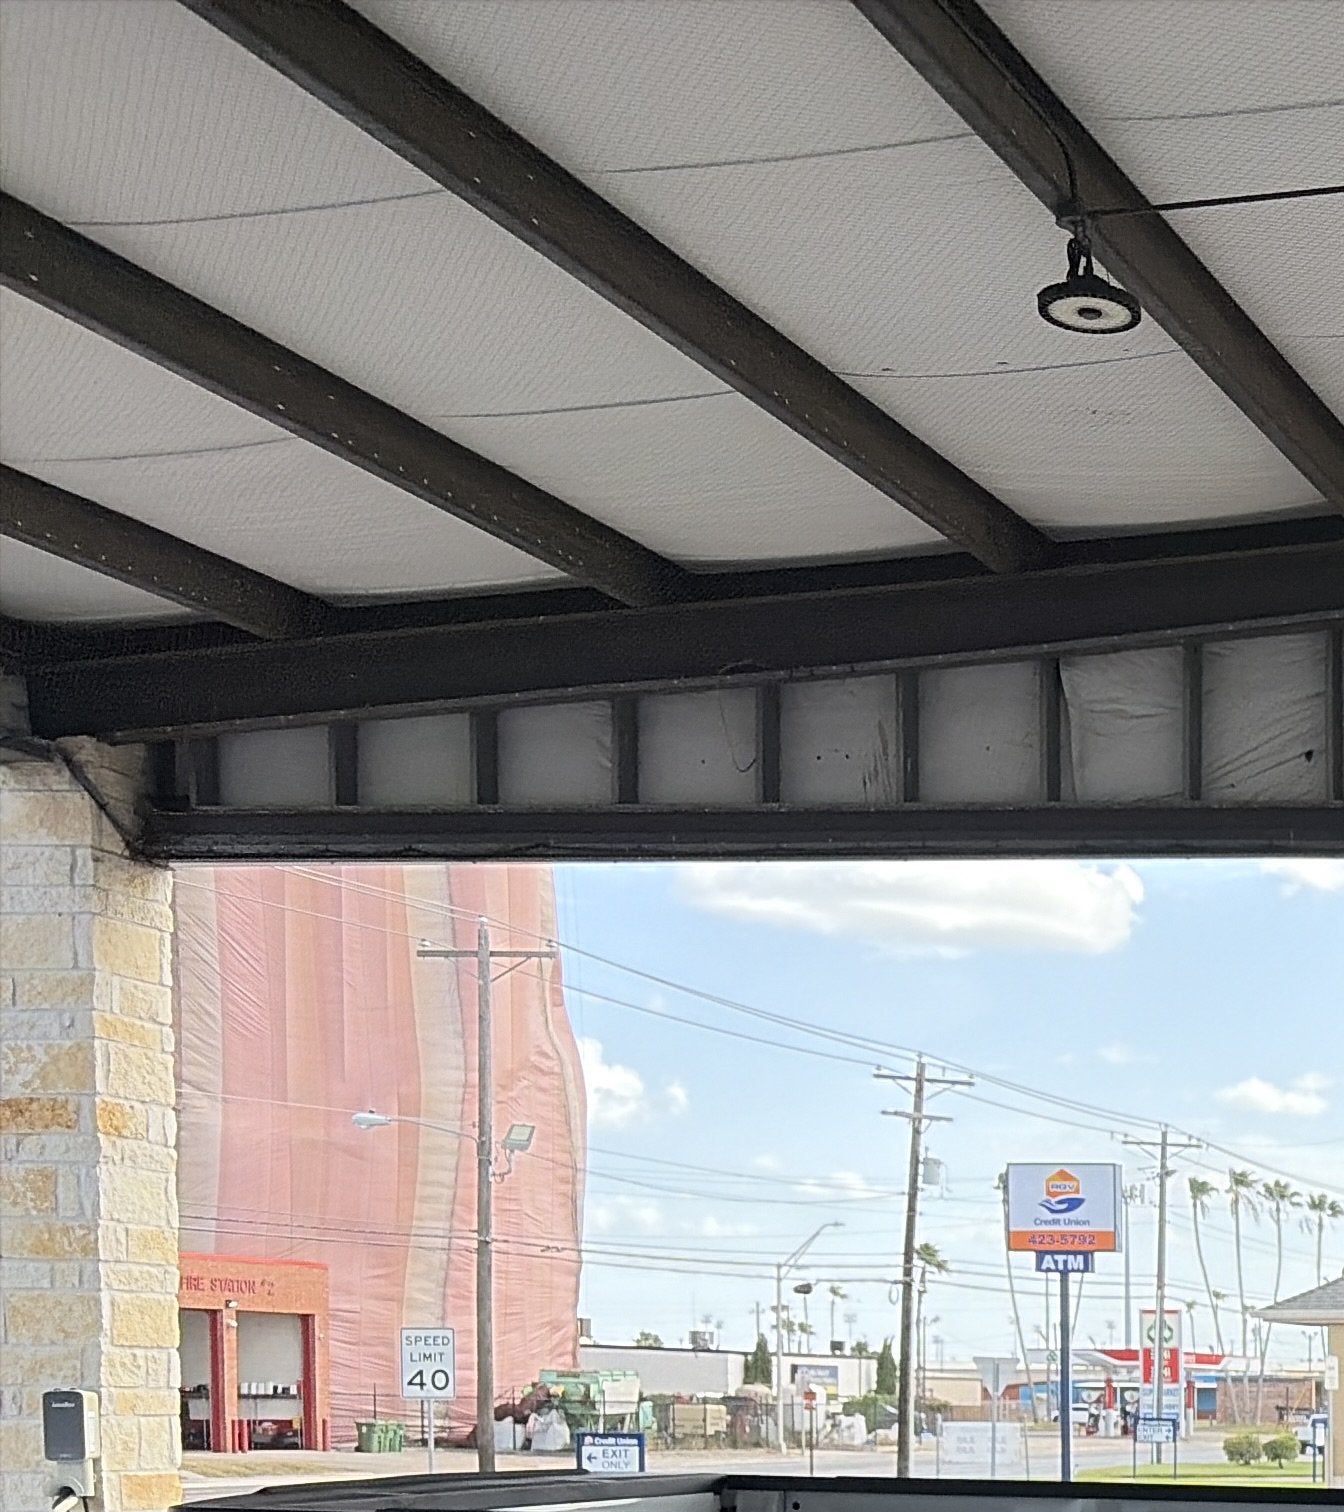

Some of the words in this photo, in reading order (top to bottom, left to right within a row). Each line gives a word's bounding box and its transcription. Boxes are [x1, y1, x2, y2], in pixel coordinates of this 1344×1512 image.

[1033, 1217, 1061, 1226] Credit
[1063, 1217, 1091, 1226] Union
[1028, 1233, 1096, 1246] 423-5792
[1040, 1254, 1084, 1271] ATM
[180, 1275, 205, 1292] FIRE
[209, 1277, 256, 1295] STATION
[405, 1335, 450, 1347] SPEED
[409, 1351, 445, 1363] LIMIT
[406, 1368, 450, 1391] 40
[602, 1448, 630, 1459] EXIT
[601, 1460, 631, 1470] ONLY
